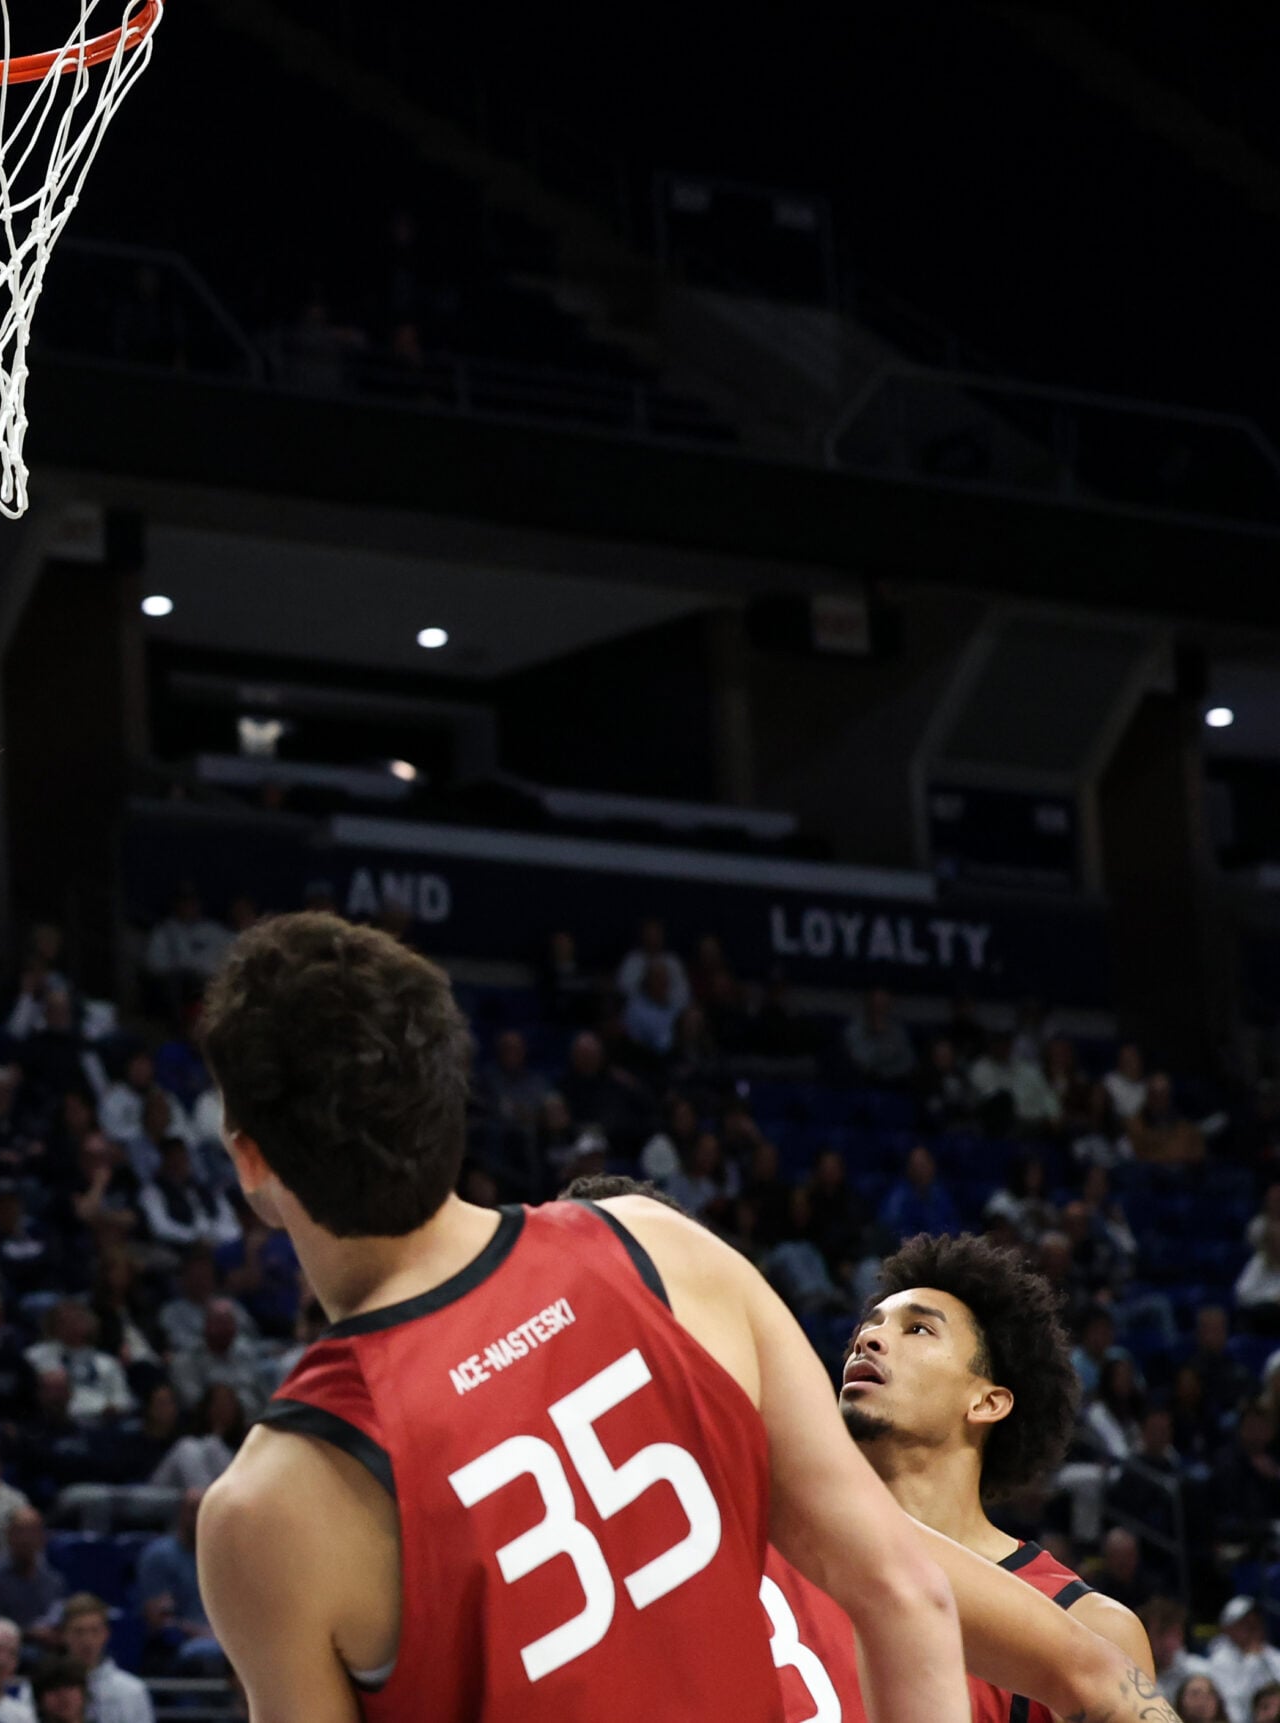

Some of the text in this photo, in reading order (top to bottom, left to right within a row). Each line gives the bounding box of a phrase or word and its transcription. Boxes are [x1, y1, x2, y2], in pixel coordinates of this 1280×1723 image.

[346, 867, 453, 924] AND
[448, 1297, 577, 1396] ACE-NASTESKI
[447, 1348, 721, 1682] 35
